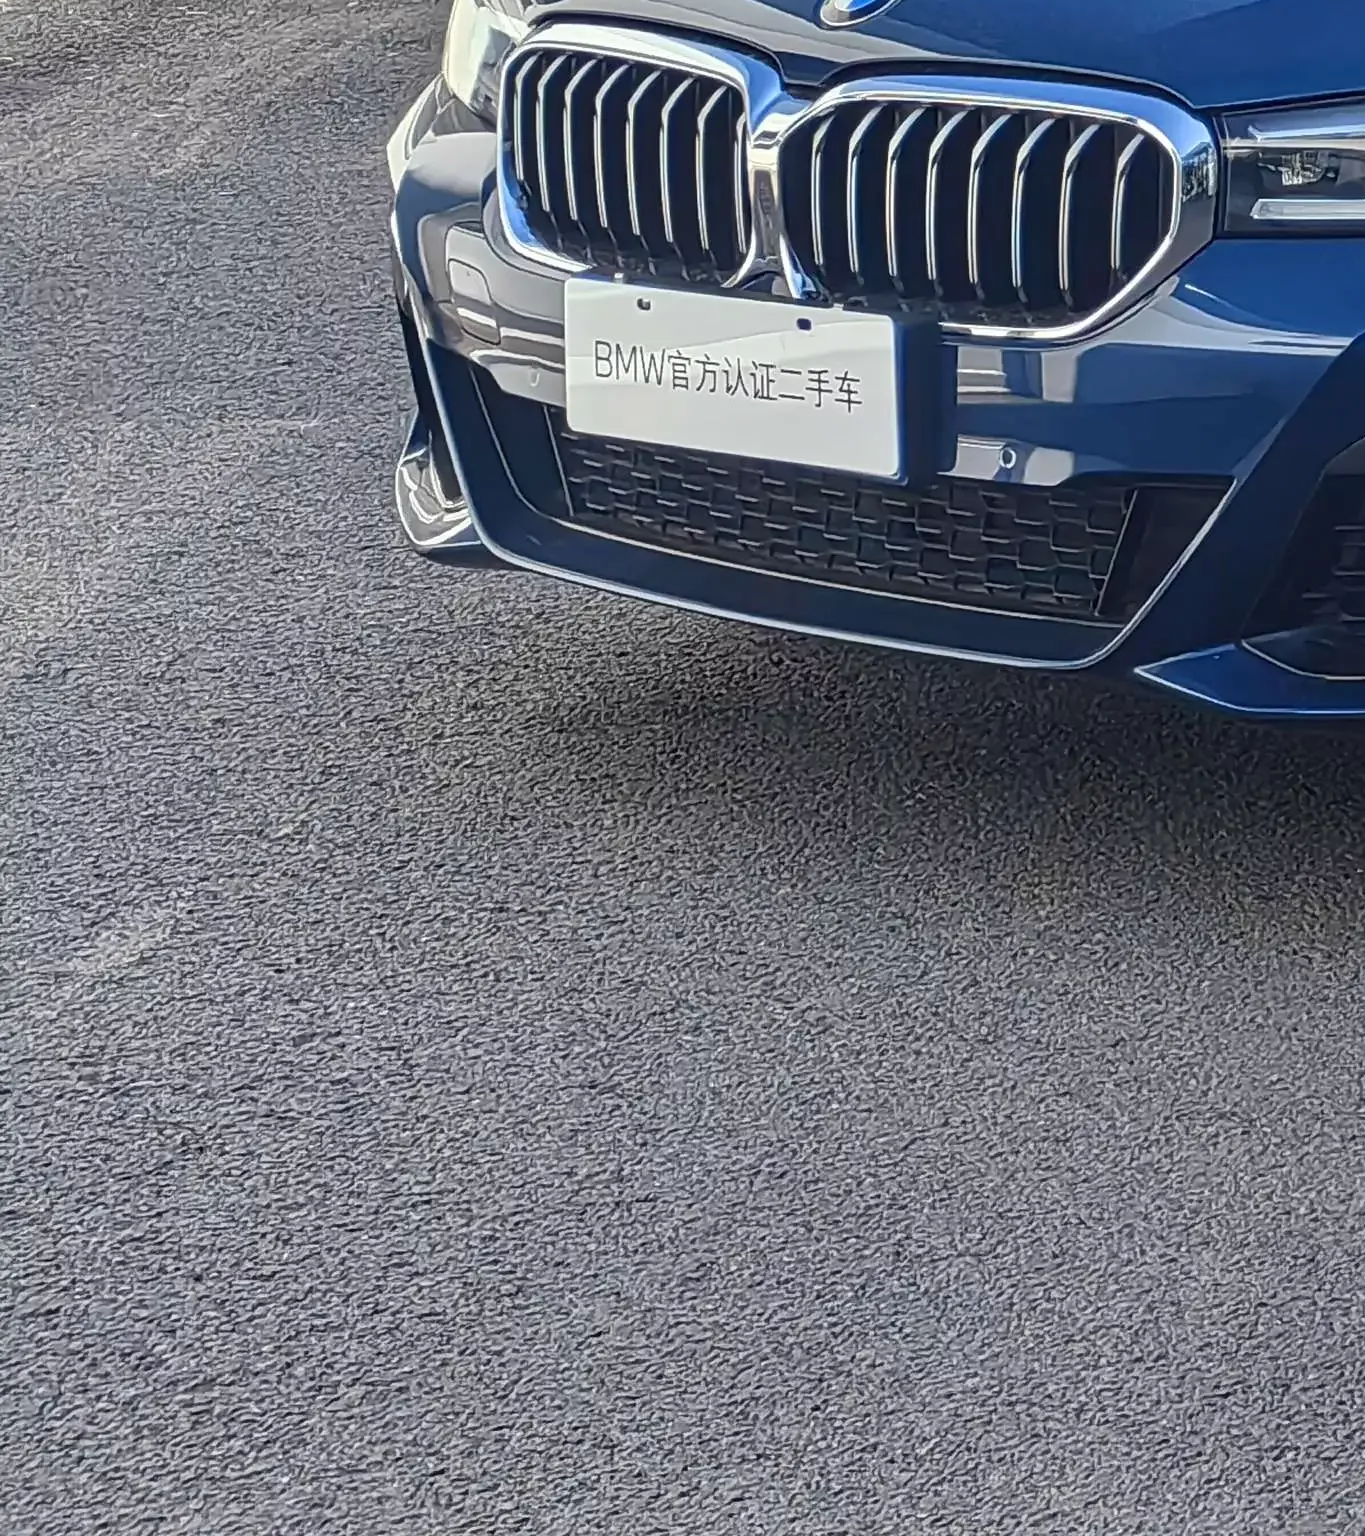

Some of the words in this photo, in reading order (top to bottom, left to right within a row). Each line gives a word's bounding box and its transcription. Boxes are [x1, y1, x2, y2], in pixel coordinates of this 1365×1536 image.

[594, 340, 863, 413] BMW官方认证二手车
